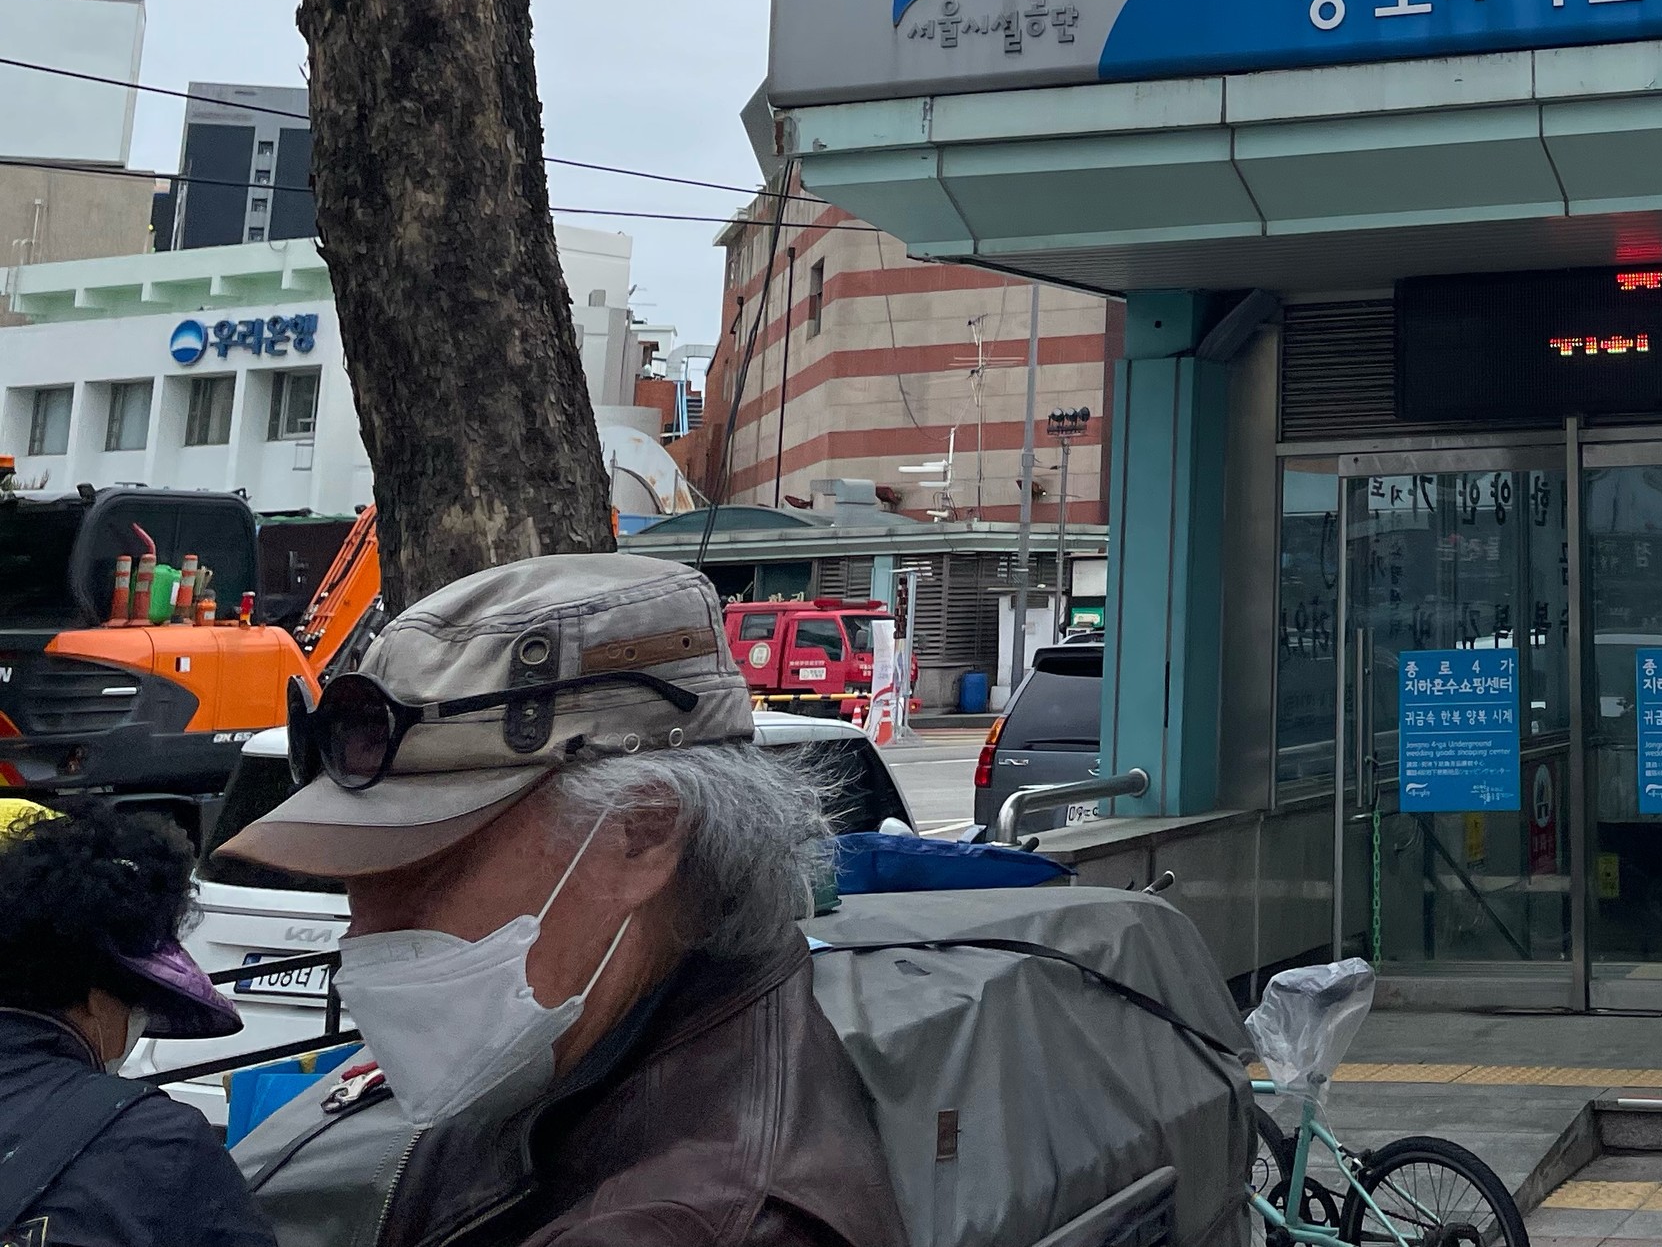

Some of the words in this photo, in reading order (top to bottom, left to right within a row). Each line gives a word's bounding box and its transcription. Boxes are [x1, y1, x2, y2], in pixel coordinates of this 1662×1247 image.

[210, 313, 319, 360] 우리은행
[1405, 711, 1436, 726] 귀금속
[1441, 710, 1462, 726] 한복
[1466, 709, 1487, 725] 양복
[1493, 708, 1513, 724] 시계
